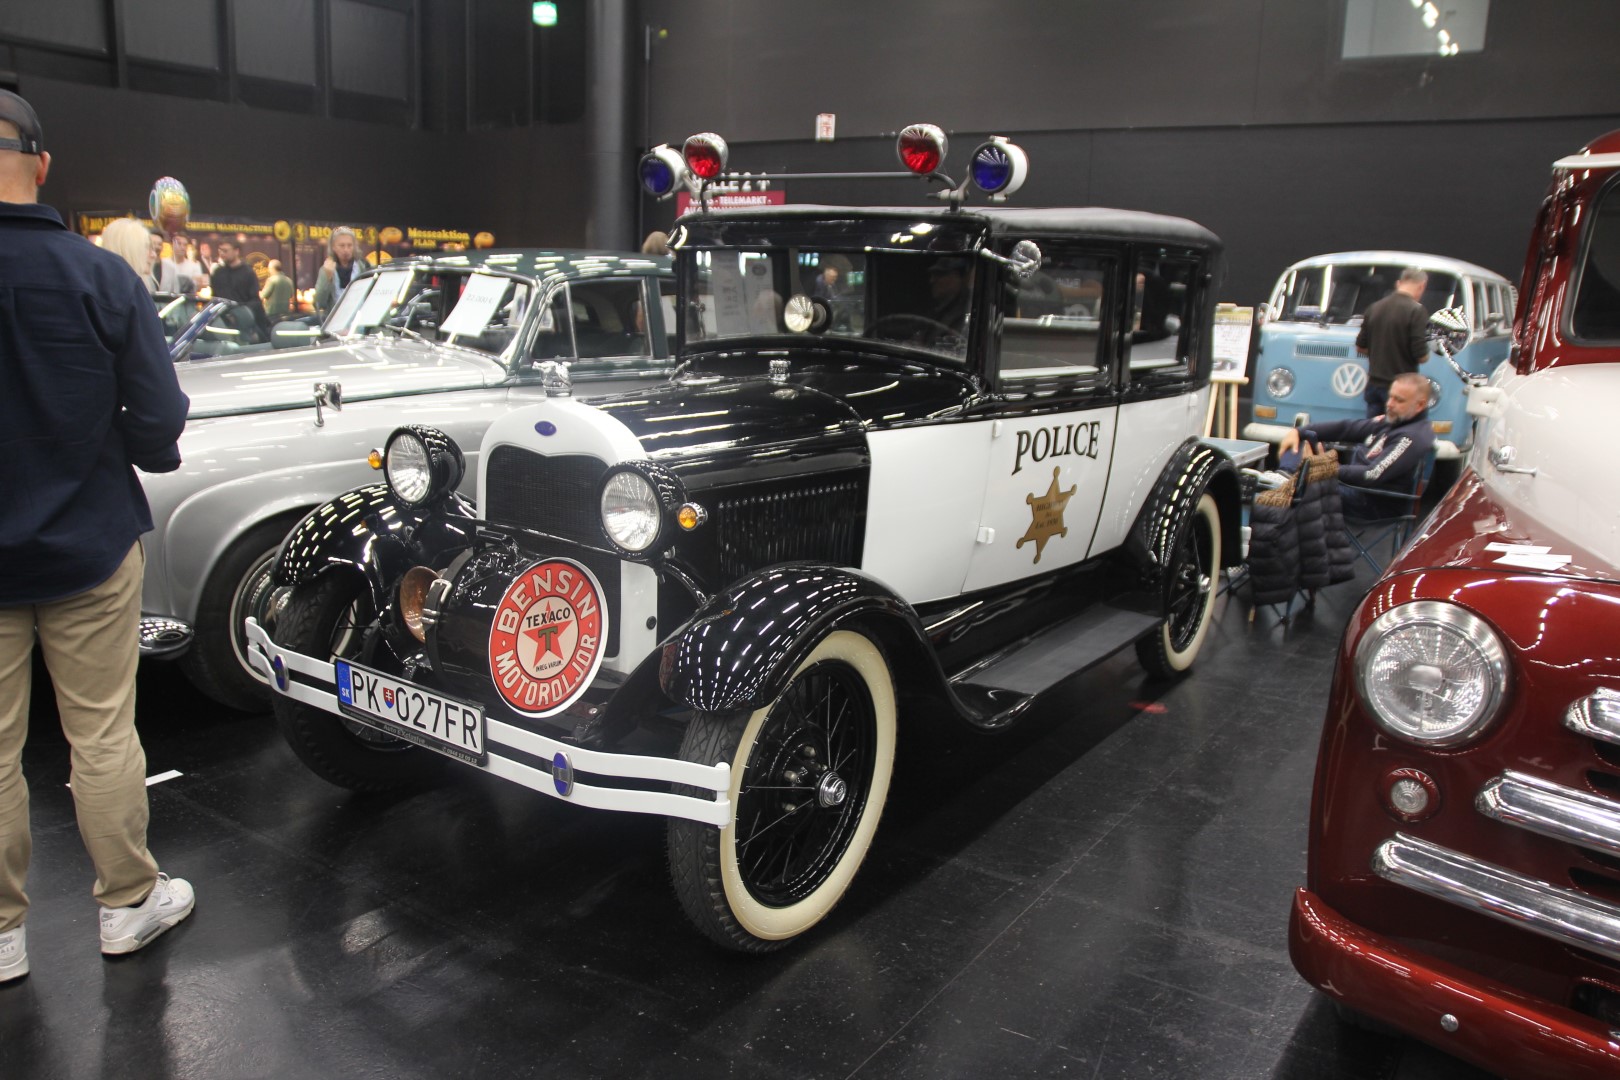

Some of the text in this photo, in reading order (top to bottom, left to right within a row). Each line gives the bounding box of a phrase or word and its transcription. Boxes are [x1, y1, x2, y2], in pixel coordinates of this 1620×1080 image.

[719, 195, 767, 205] TEILEMARKT
[216, 222, 273, 233] MANUFACTURE
[407, 227, 470, 240] Messeaktion
[1335, 364, 1366, 396] VW
[1011, 420, 1101, 476] POLICE
[496, 568, 597, 635] BENSIN
[525, 607, 571, 628] TEXACO
[538, 626, 559, 652] T
[495, 633, 597, 706] MOTOROLJOR
[341, 687, 351, 698] SK
[351, 670, 478, 749] PK 027FR
